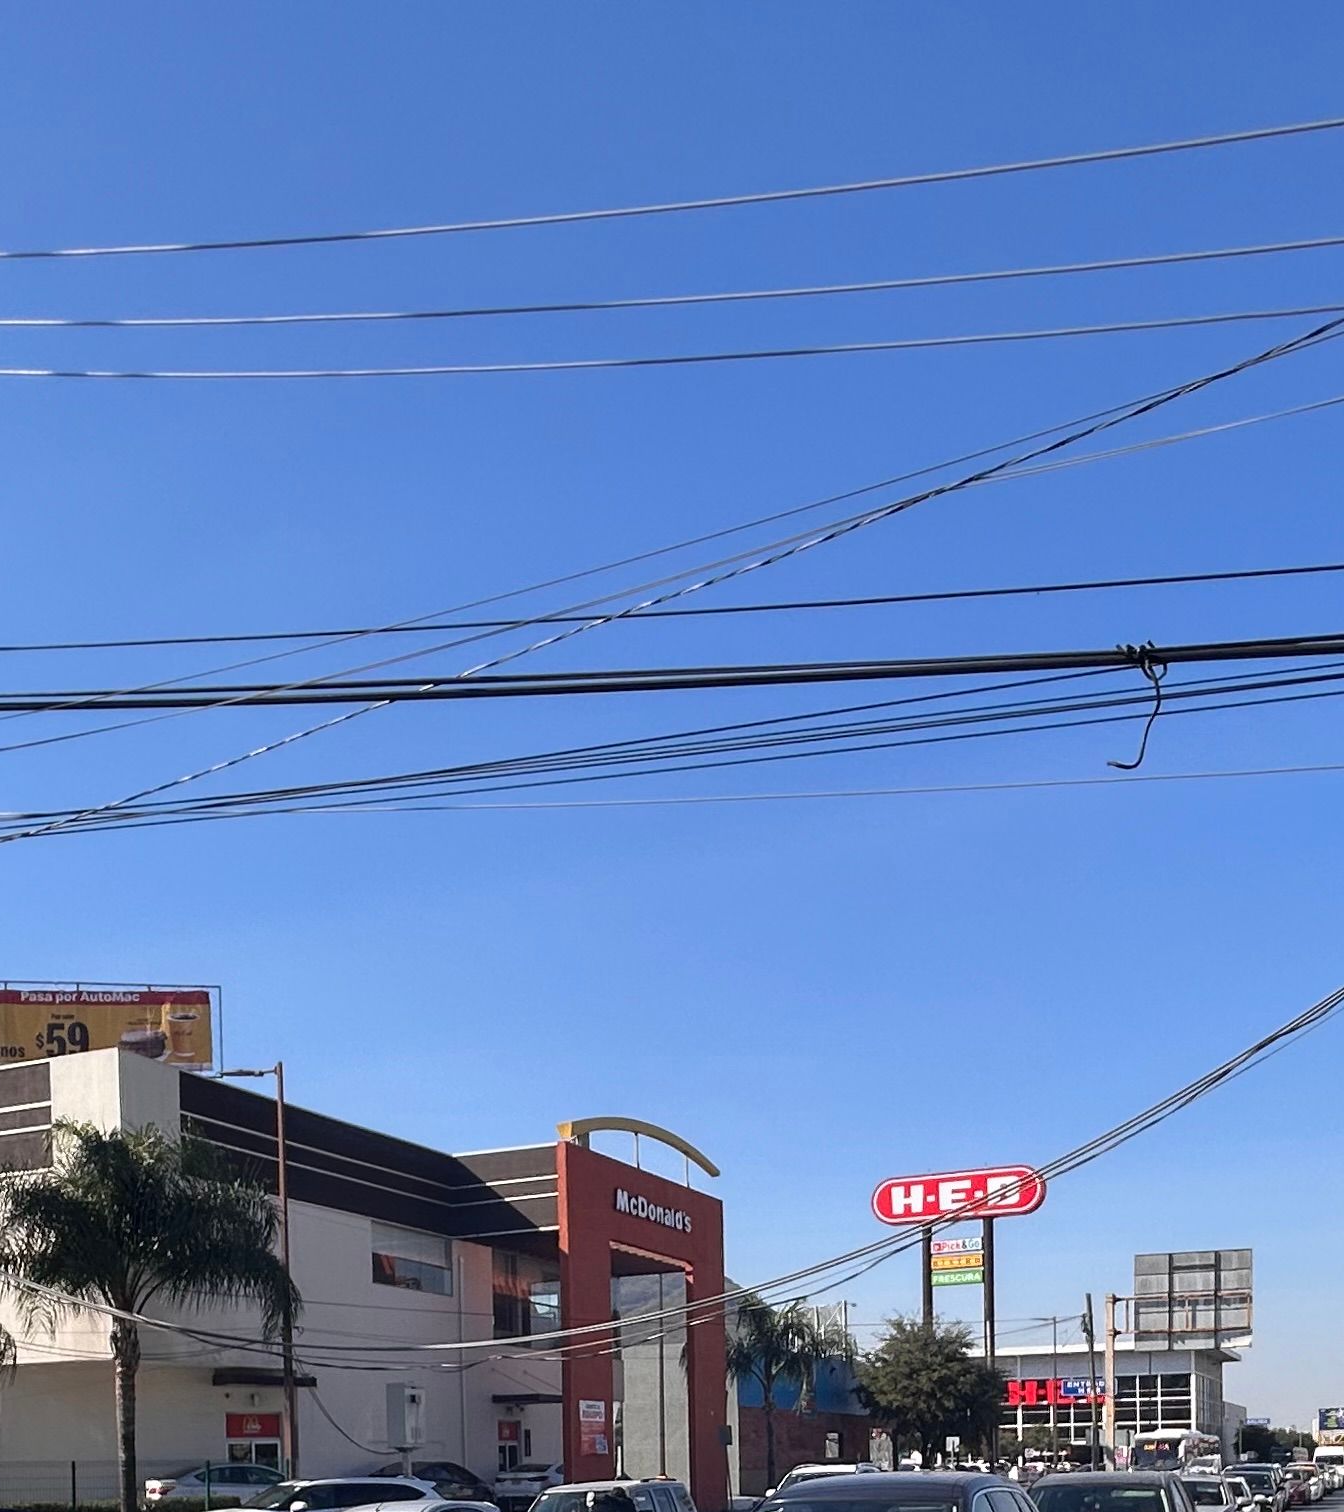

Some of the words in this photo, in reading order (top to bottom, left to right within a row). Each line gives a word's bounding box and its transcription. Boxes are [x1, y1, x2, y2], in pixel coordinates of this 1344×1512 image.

[20, 990, 53, 1002] Pasa
[56, 992, 77, 1004] por
[80, 991, 140, 1002] AutoMac
[36, 1022, 89, 1057] $59
[616, 1188, 692, 1233] McDonald's
